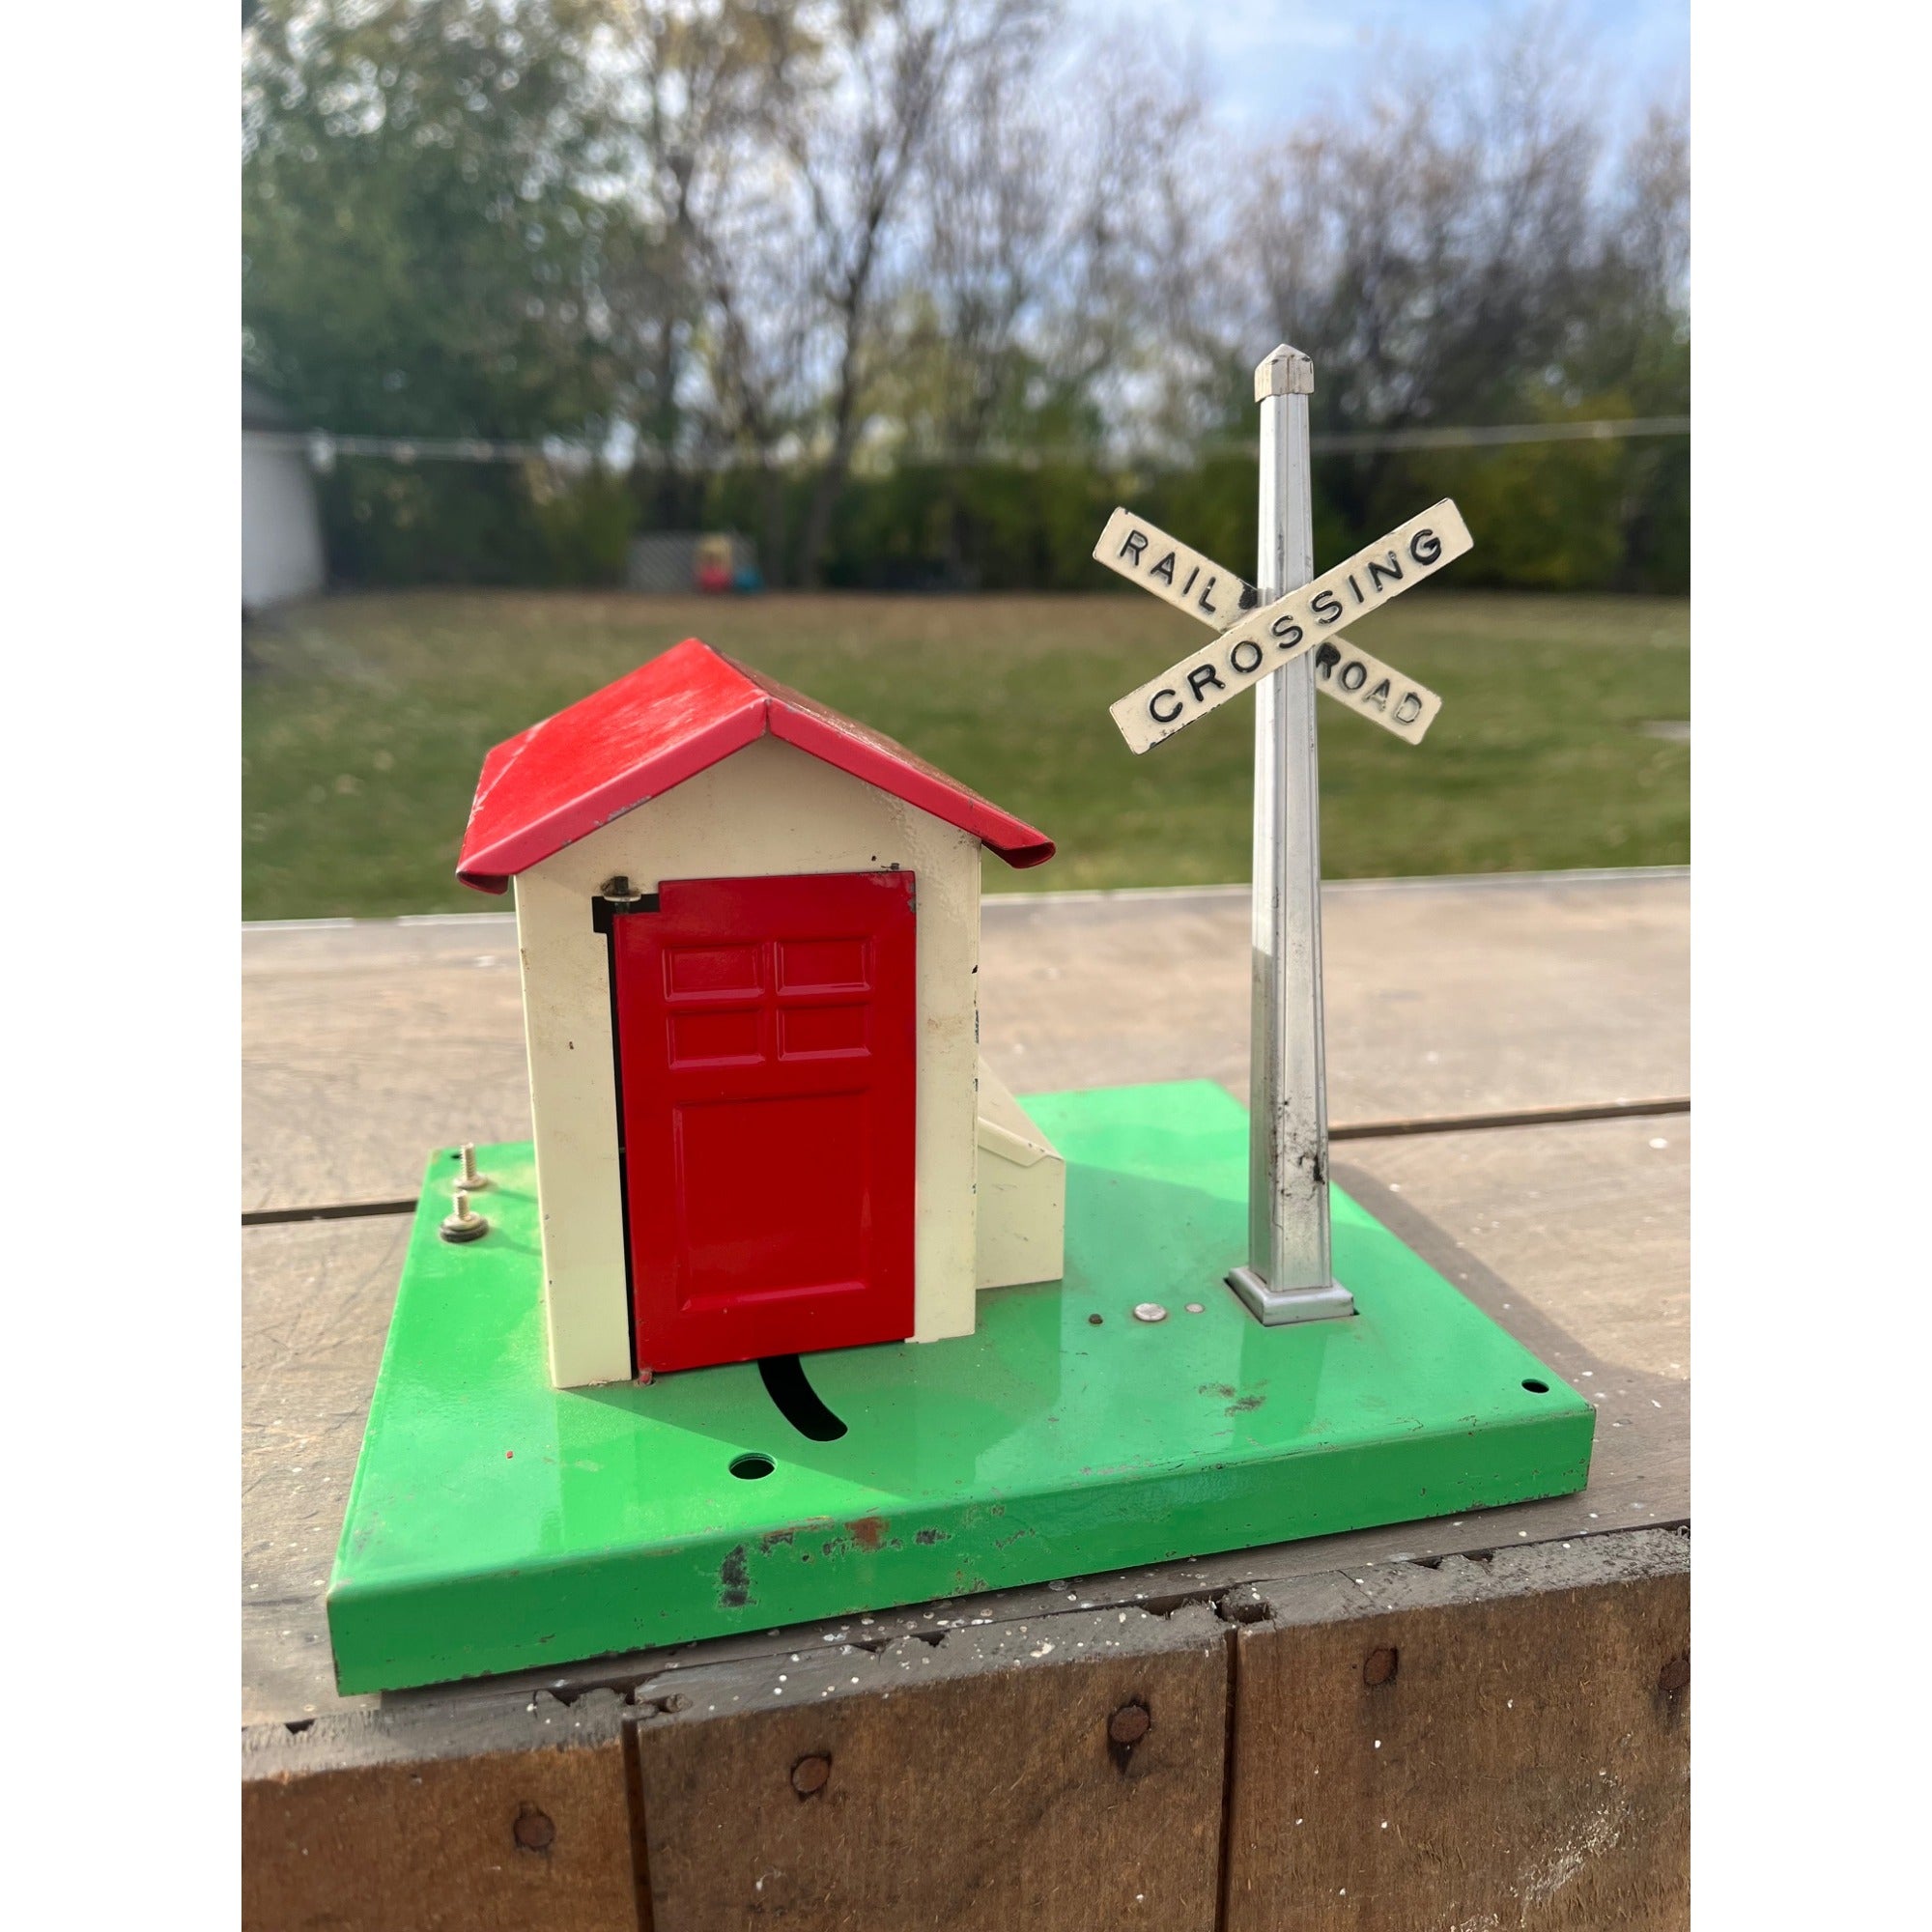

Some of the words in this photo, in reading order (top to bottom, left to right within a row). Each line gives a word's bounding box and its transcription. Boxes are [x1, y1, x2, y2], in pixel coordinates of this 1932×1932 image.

[1120, 529, 1216, 613] RAIL
[1315, 641, 1423, 724] ROAD
[1148, 527, 1442, 724] CROSSING
